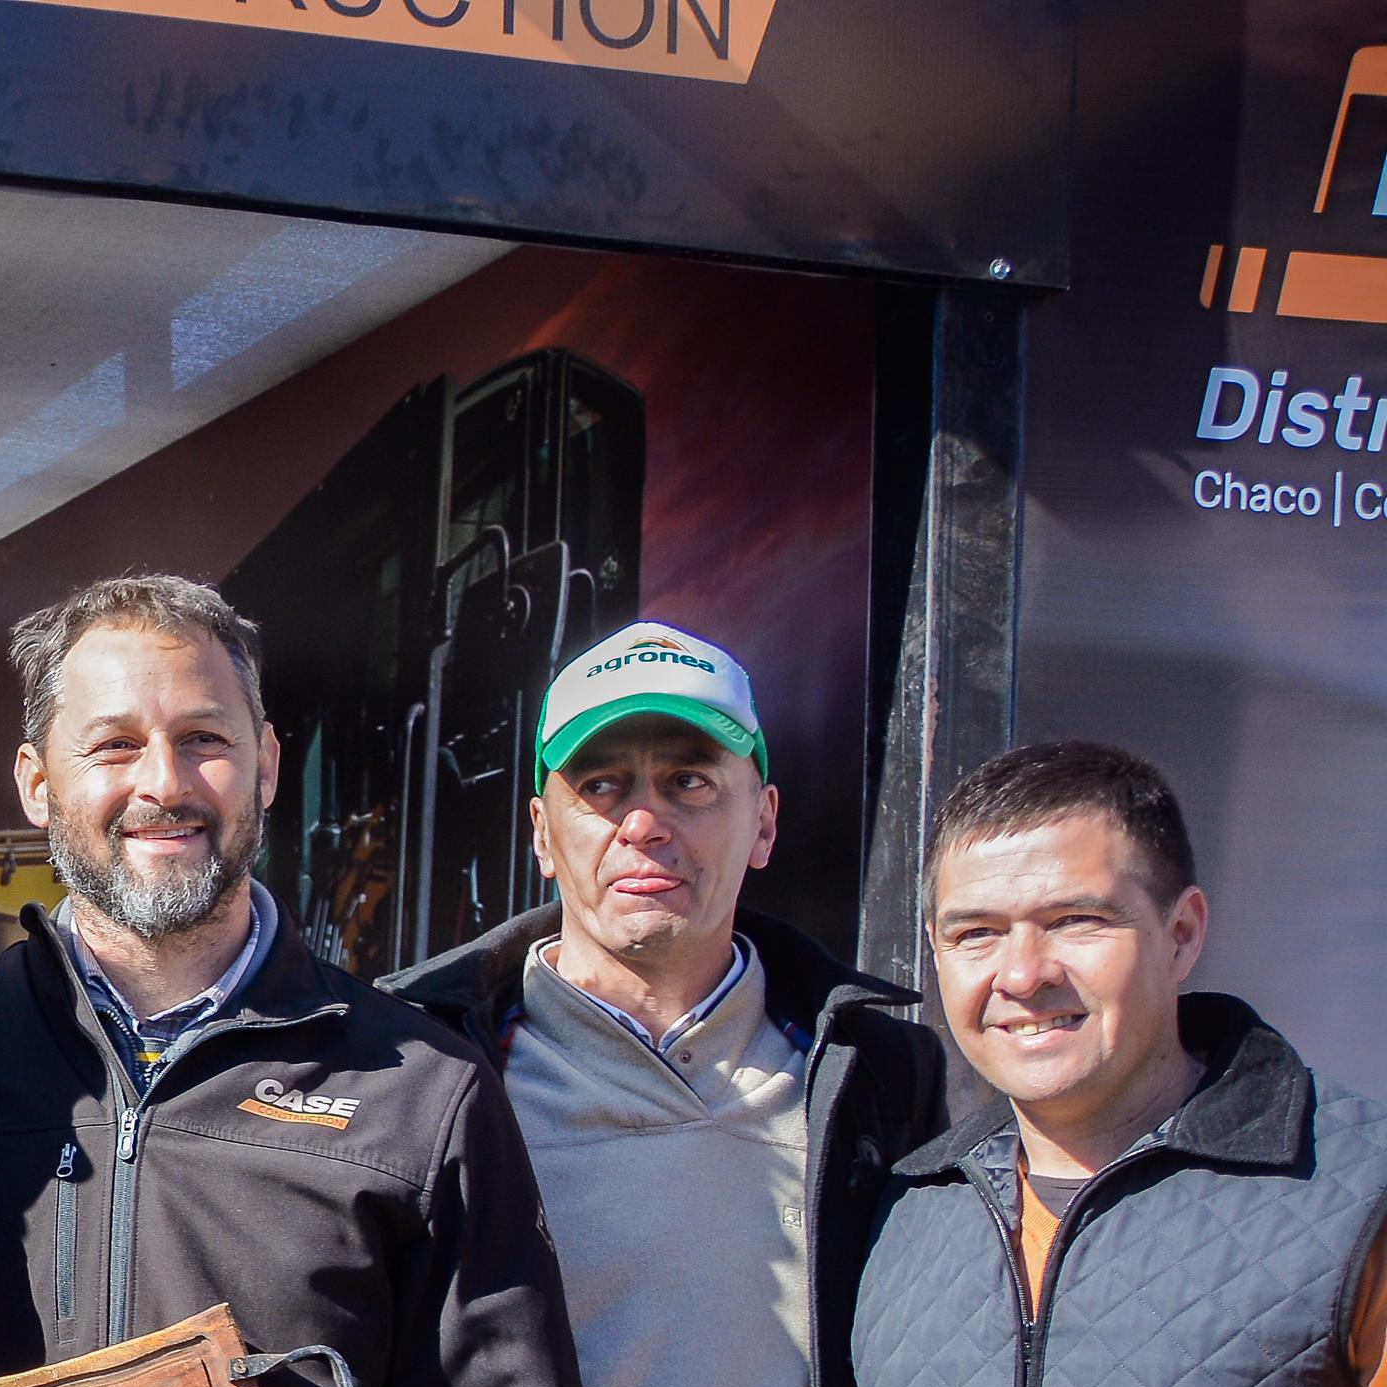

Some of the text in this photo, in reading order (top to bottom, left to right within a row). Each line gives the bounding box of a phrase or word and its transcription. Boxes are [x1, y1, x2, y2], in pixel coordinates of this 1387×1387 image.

[1194, 470, 1387, 520] Chaco C
[586, 651, 716, 678] agronea
[255, 1078, 361, 1119] CASE
[257, 1104, 347, 1129] CONSTRUCTION
